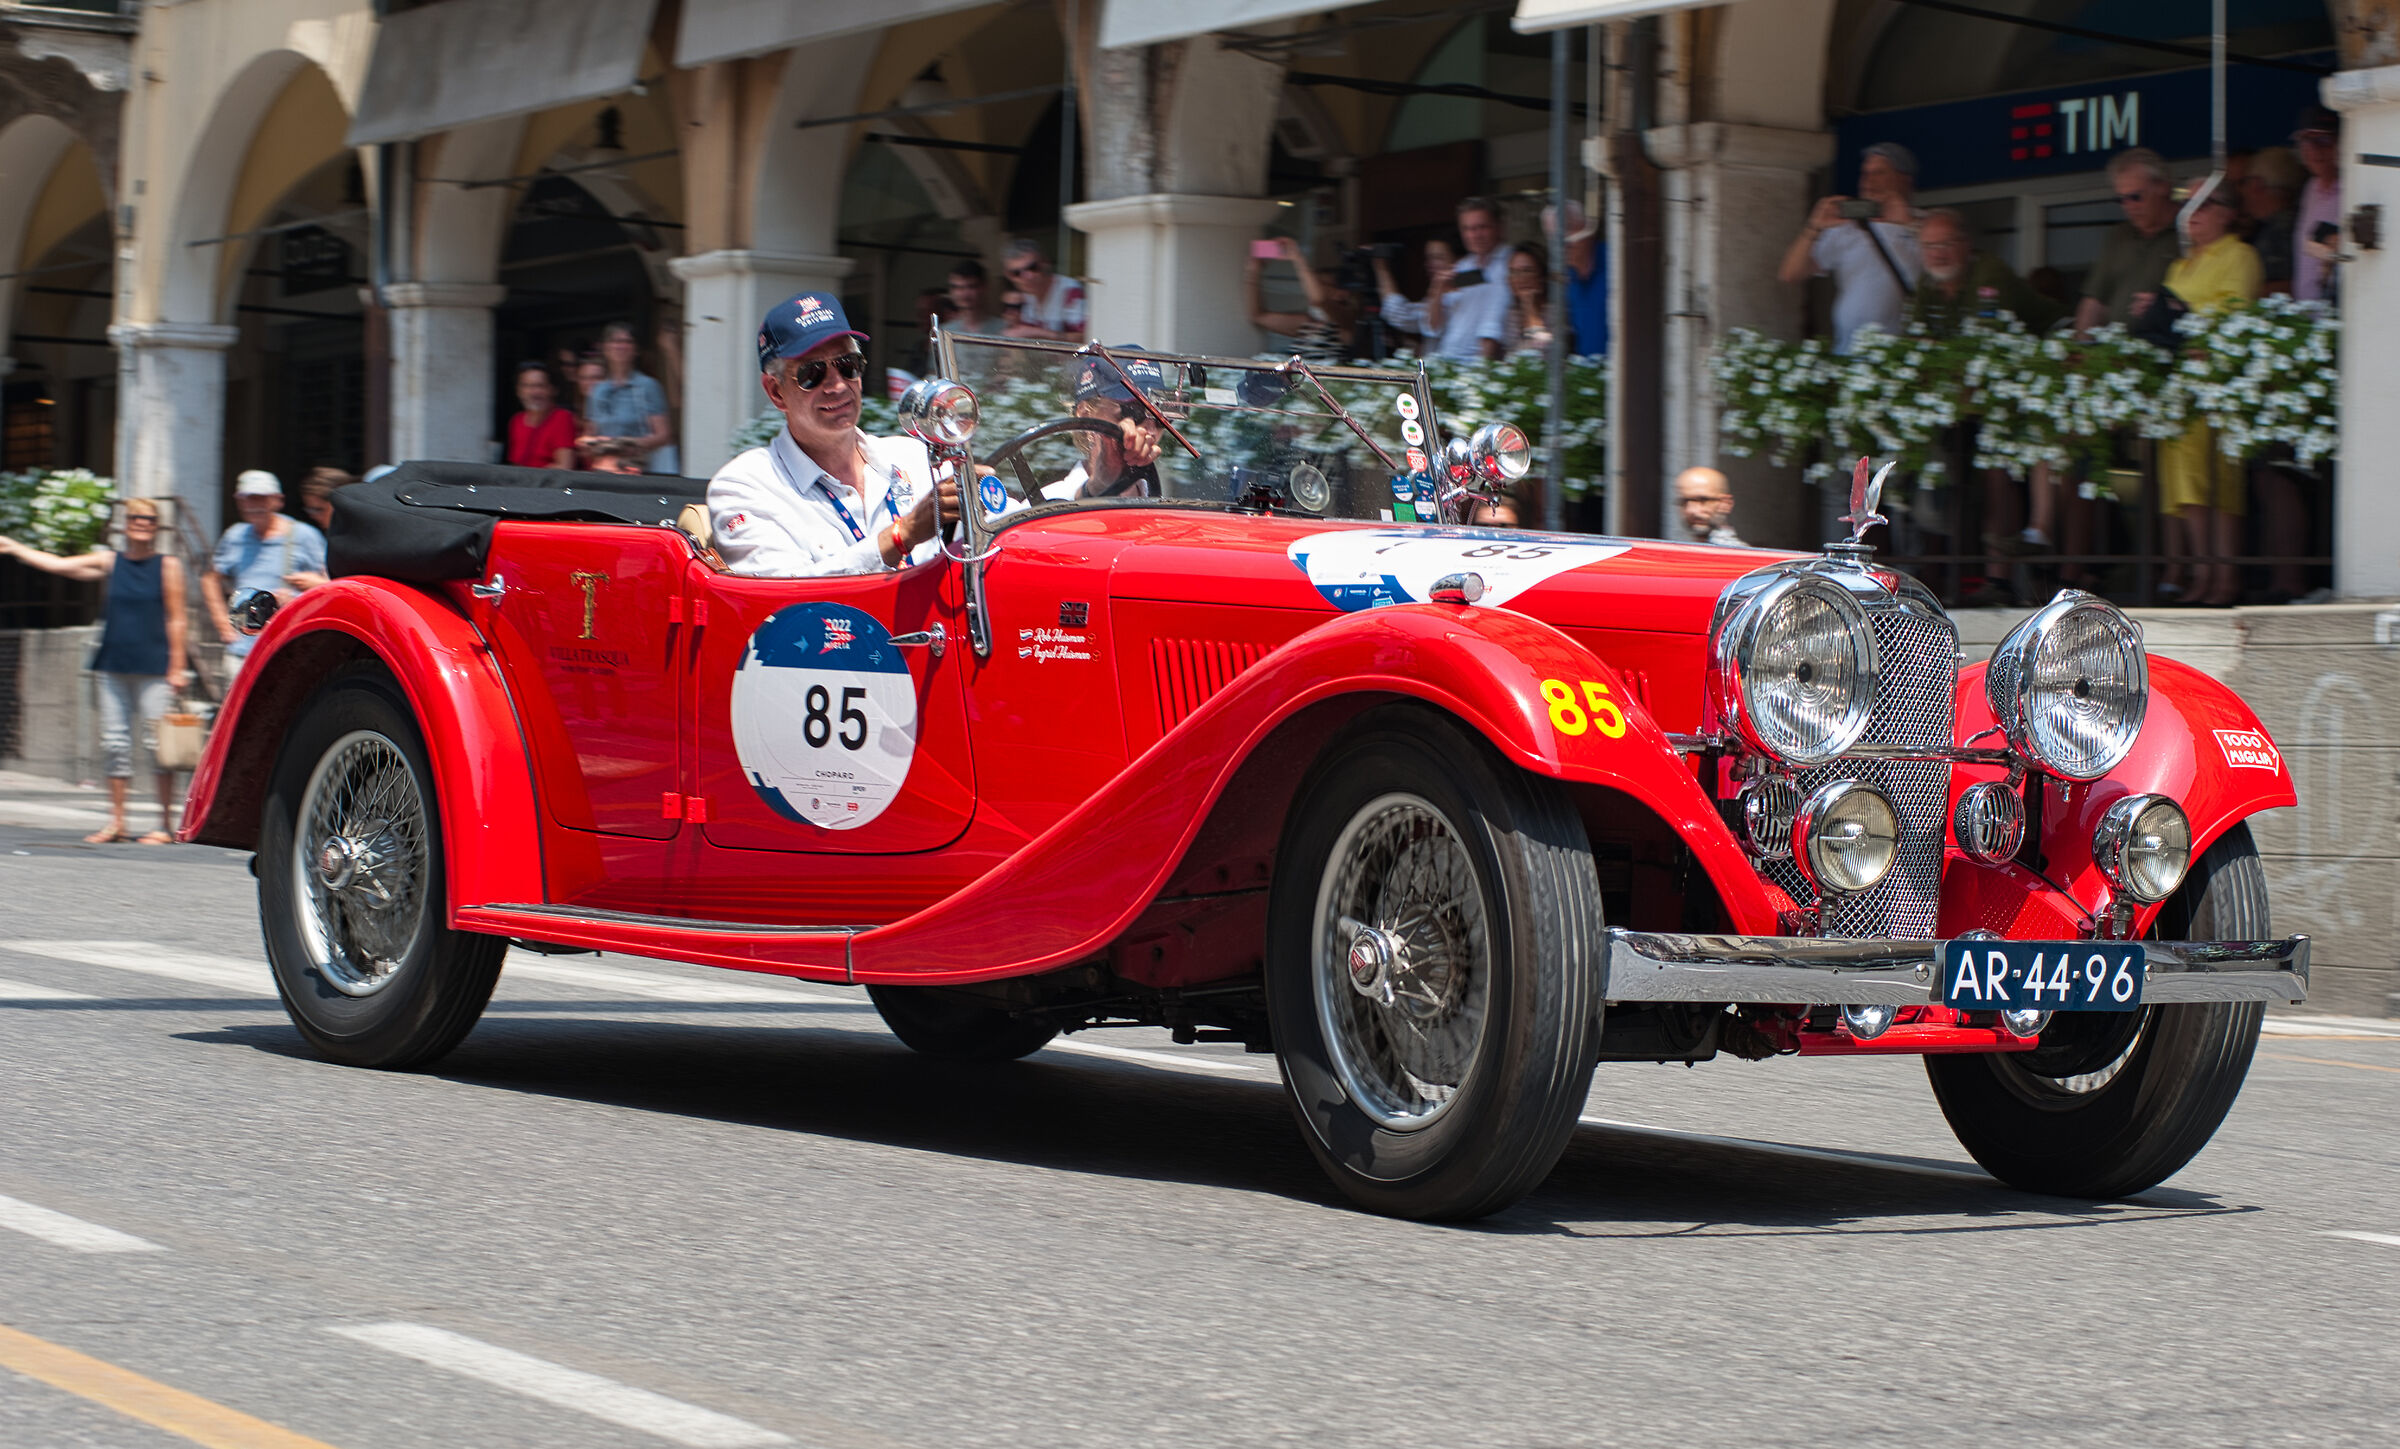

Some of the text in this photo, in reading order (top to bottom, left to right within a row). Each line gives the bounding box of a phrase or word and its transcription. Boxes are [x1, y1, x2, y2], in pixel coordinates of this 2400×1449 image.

[2059, 91, 2139, 154] TIM
[1461, 544, 1567, 560] 85
[824, 618, 852, 632] 2022
[1540, 678, 1627, 739] 85
[803, 684, 868, 751] 85
[2223, 733, 2262, 749] 1000
[2229, 749, 2273, 766] MIGLIA
